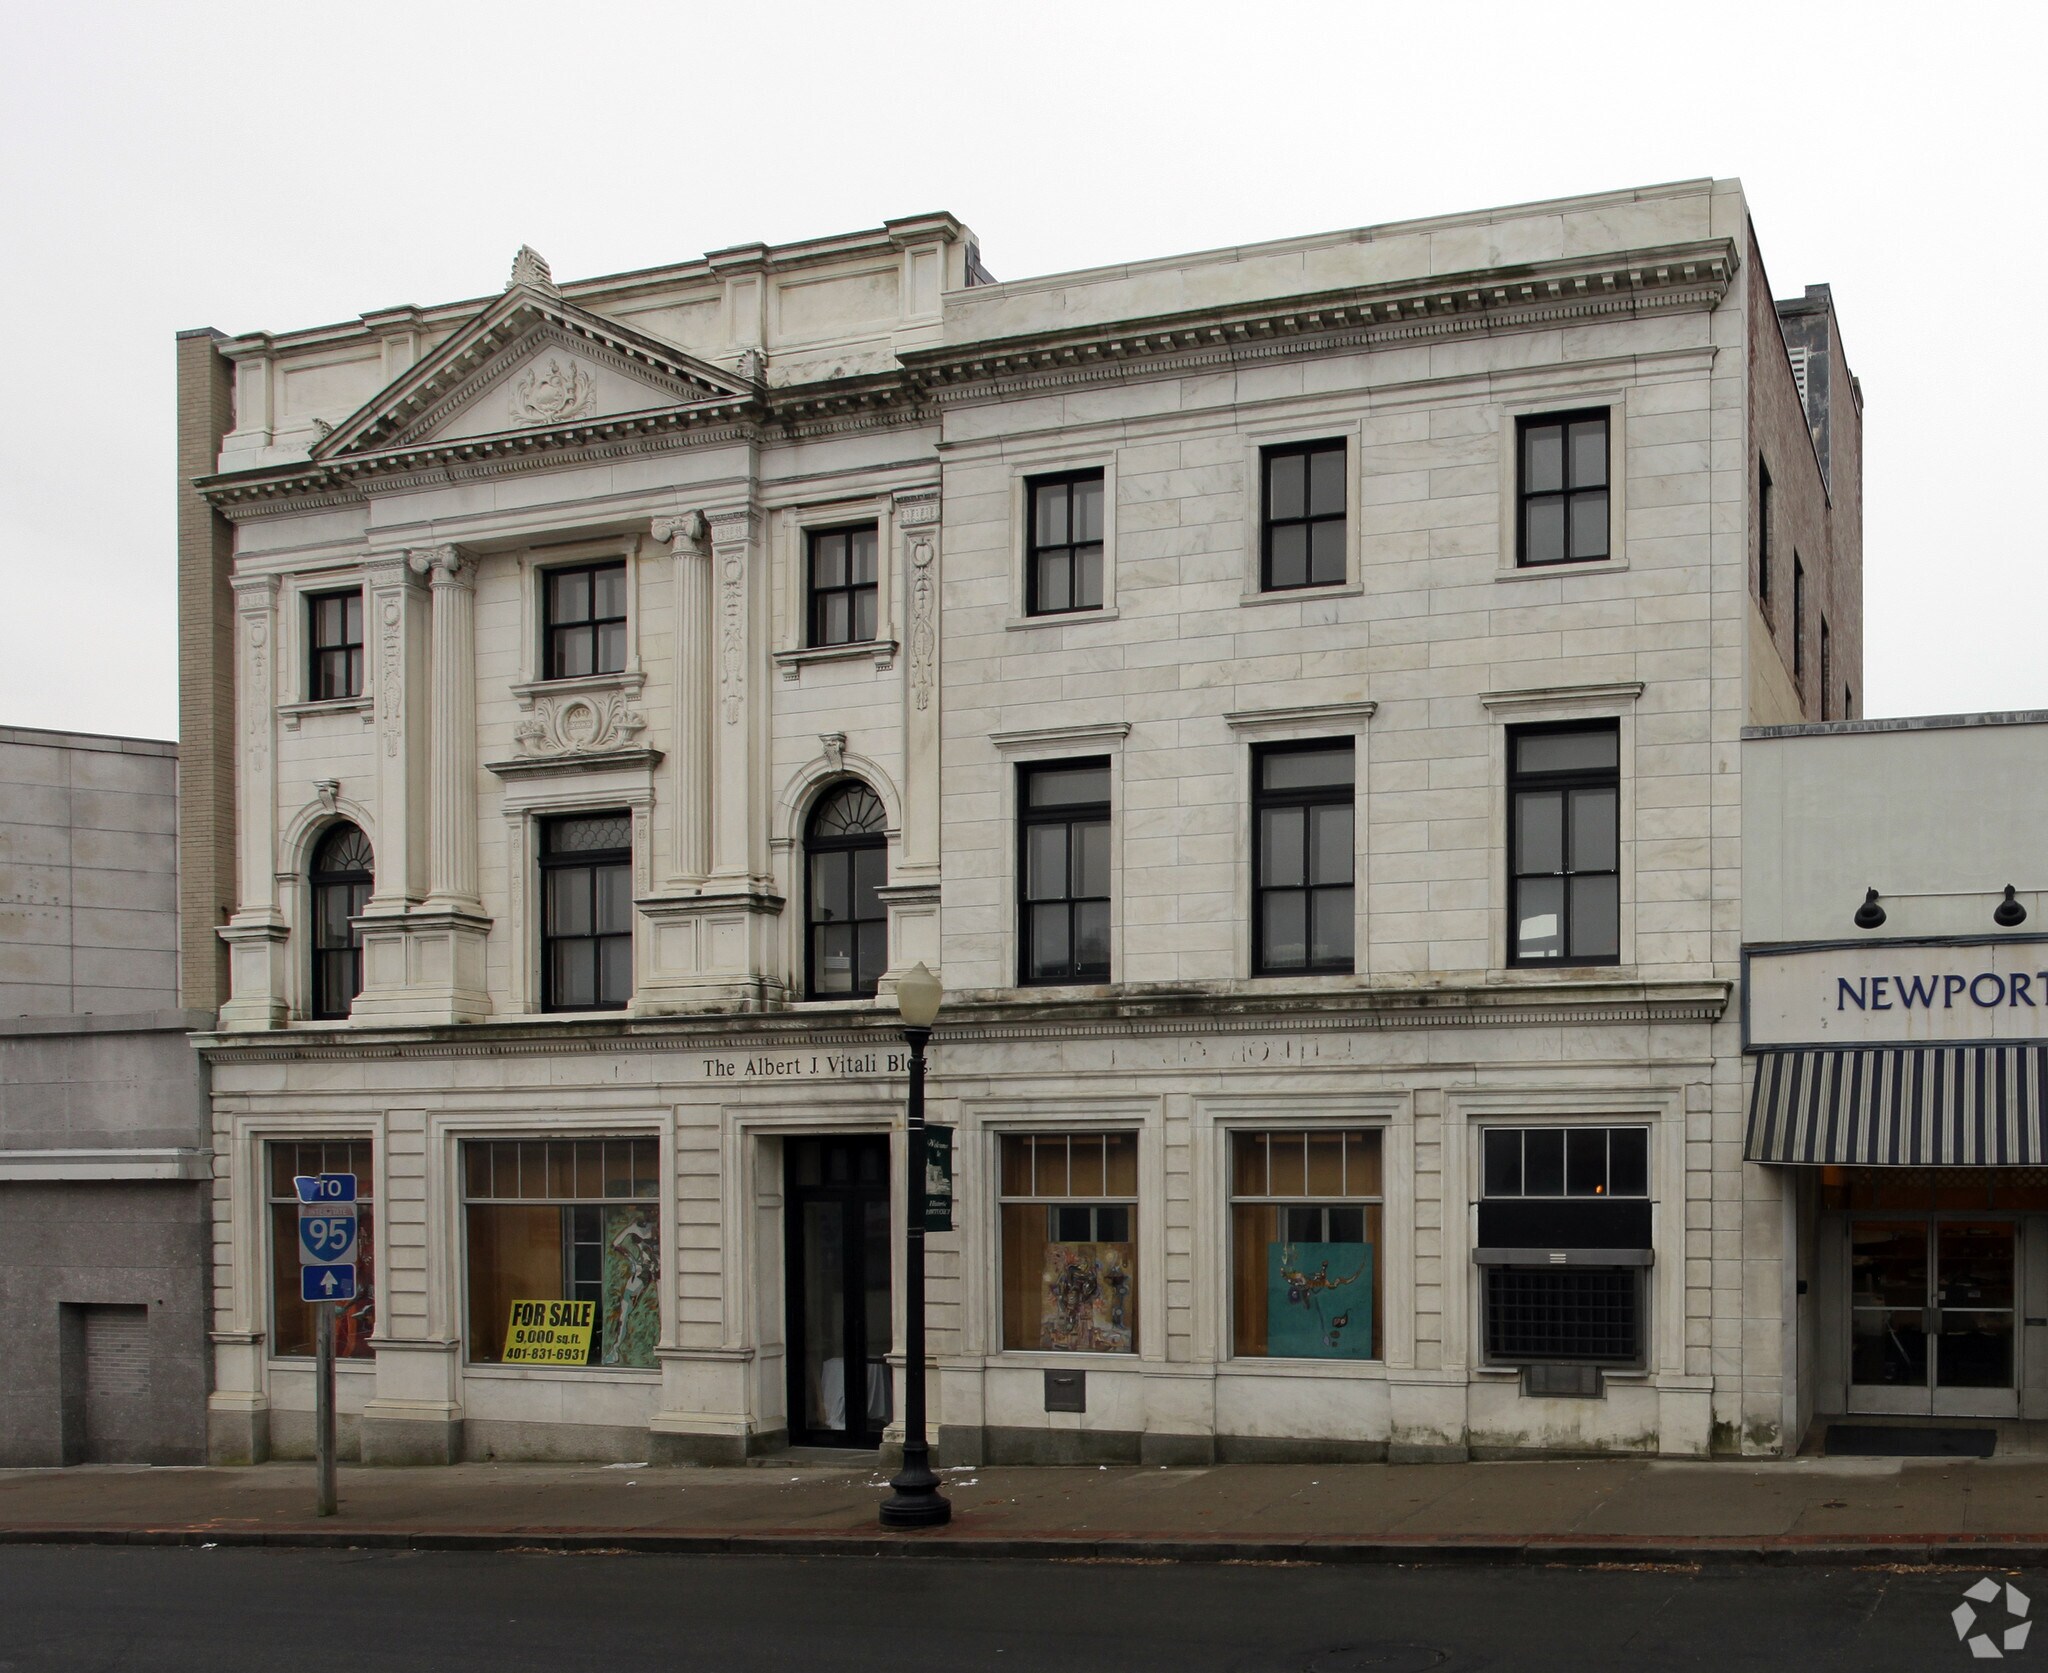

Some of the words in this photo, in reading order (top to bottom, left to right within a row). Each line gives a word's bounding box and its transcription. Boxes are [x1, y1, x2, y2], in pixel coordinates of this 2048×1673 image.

[703, 1059, 735, 1077] The
[744, 1056, 801, 1076] Albert
[809, 1056, 819, 1075] J.
[826, 1054, 876, 1074] Vitali
[314, 1179, 342, 1197] TO
[309, 1219, 347, 1251] 95
[512, 1303, 546, 1327] FOR
[549, 1303, 592, 1327] SALE
[515, 1330, 555, 1344] 9,000
[556, 1334, 581, 1345] sq.ft.
[506, 1347, 586, 1361] 401-831-6931
